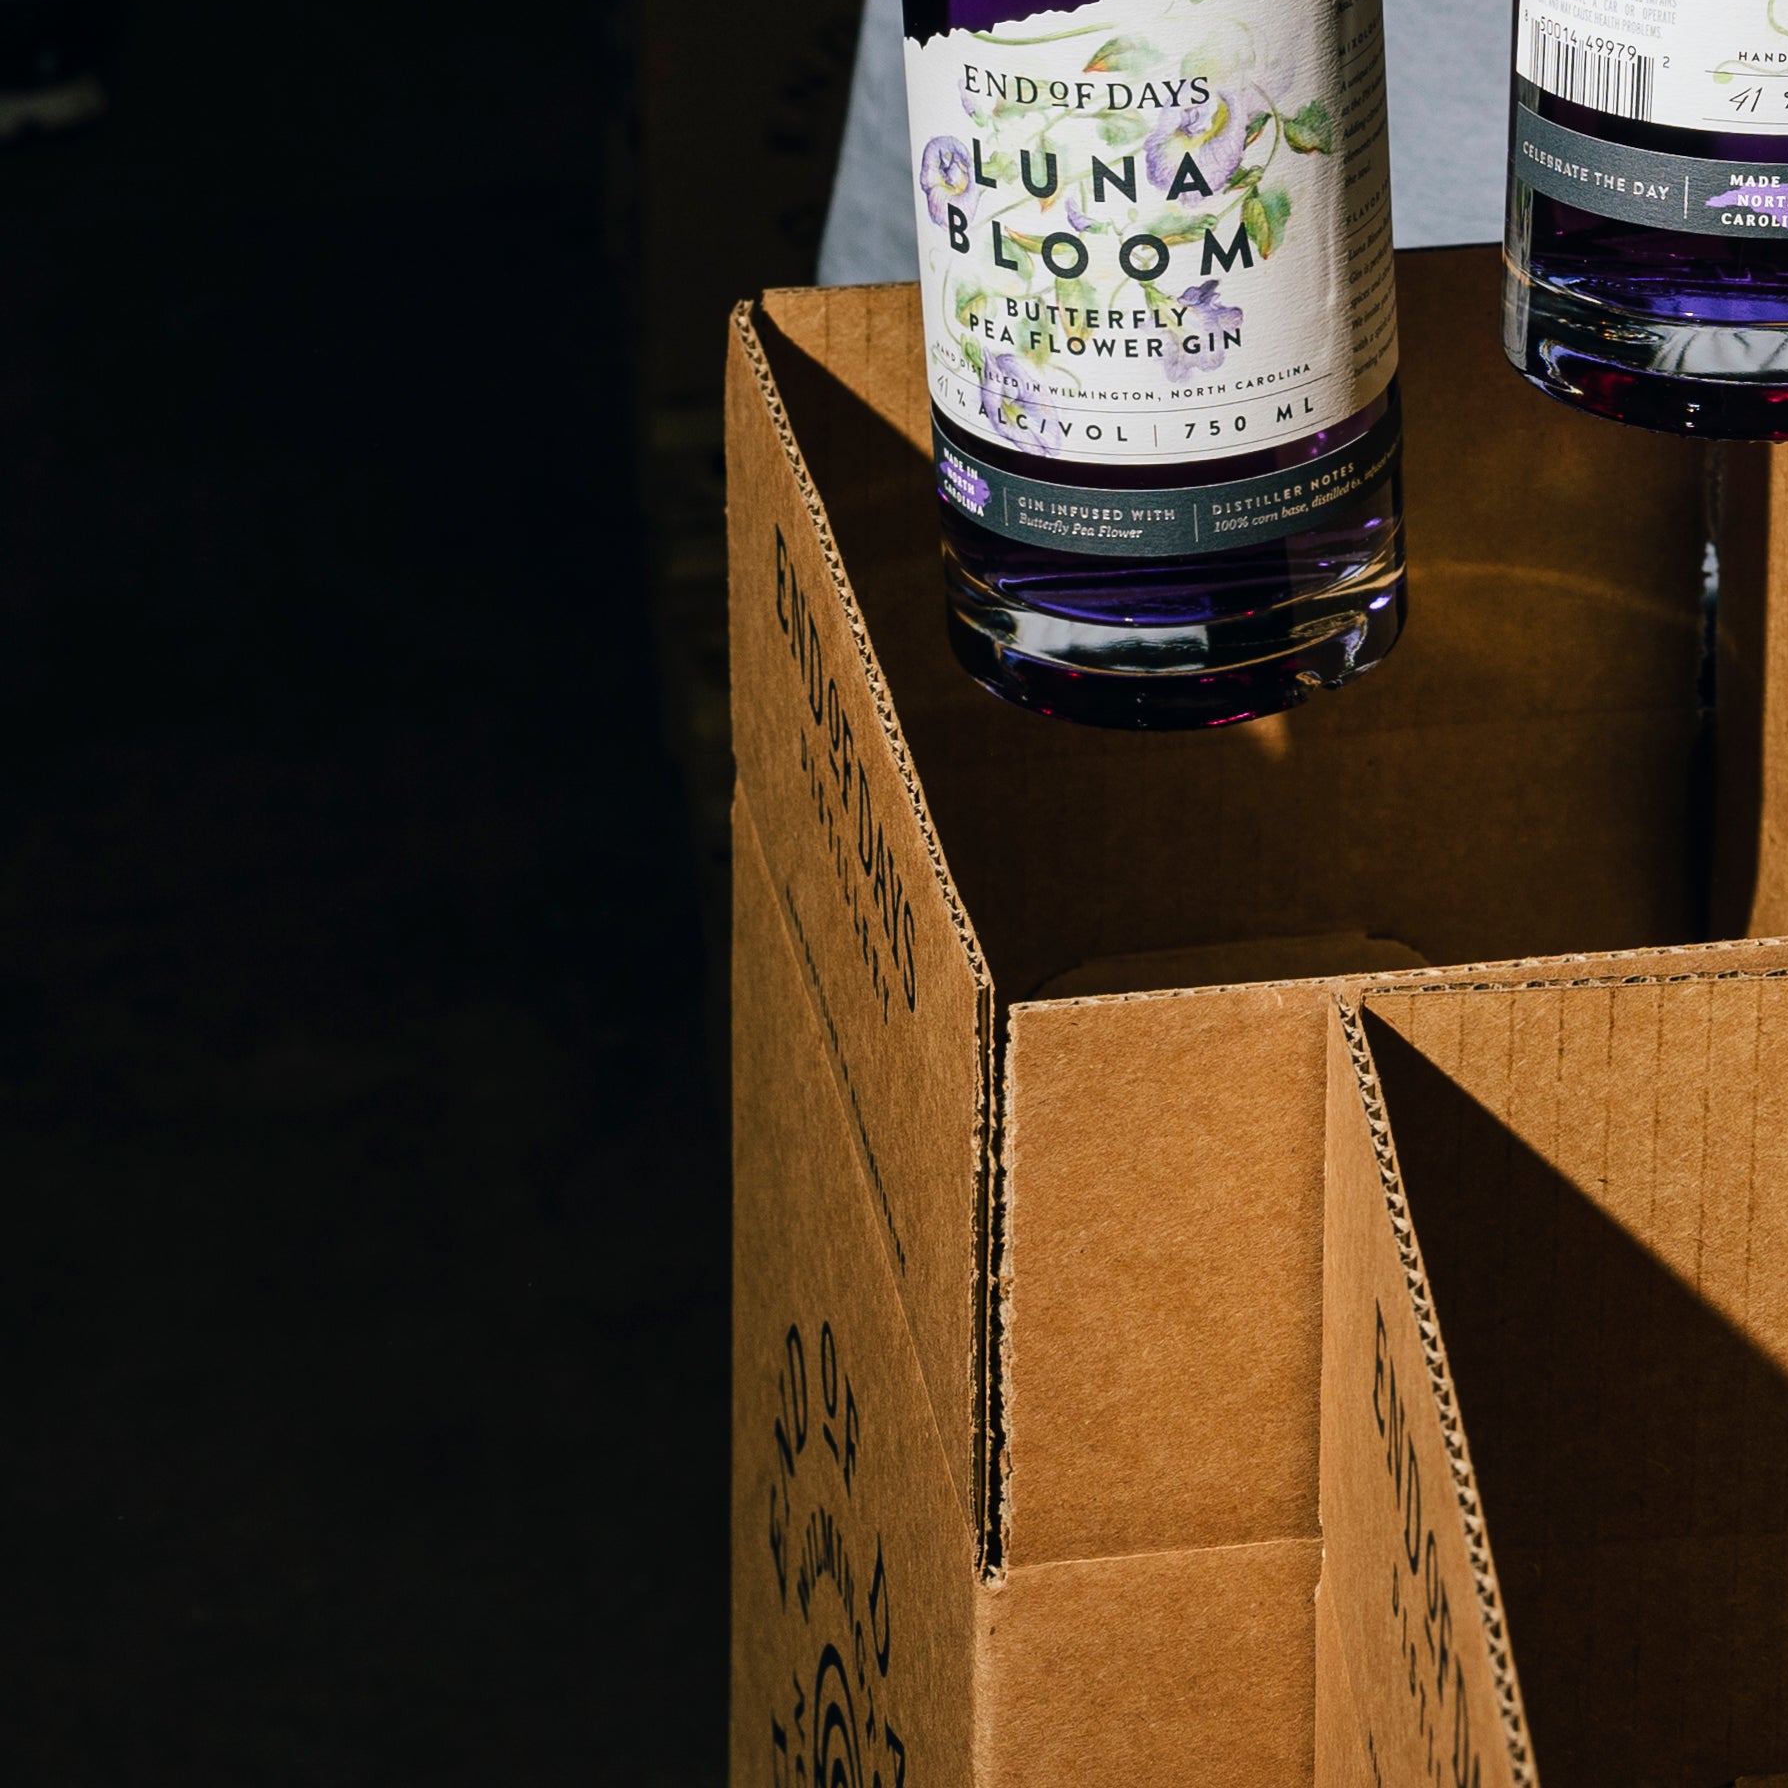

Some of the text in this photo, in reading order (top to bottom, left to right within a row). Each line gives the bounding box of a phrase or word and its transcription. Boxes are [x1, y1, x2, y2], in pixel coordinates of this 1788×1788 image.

[1594, 12, 1620, 30] HEALTH
[1625, 3, 1635, 17] OR
[1643, 8, 1677, 25] OPERATE
[1540, 16, 1578, 44] 50014
[1585, 35, 1637, 61] 49979
[1662, 55, 1671, 69] 2
[1738, 51, 1788, 63] HAND
[963, 63, 1210, 110] END OF DAYS
[1728, 86, 1764, 113] 41
[972, 137, 1214, 204] LUNA
[1522, 140, 1670, 201] CELEBRATE THE DAY
[1729, 173, 1784, 189] MADE
[947, 202, 1254, 281] BLOOM
[969, 313, 1244, 359] PEA FLOWER GIN
[1006, 297, 1188, 330] BUTTERFLY
[959, 357, 1020, 389] DISTILLED
[1025, 382, 1041, 394] IN
[1047, 385, 1162, 402] WILMINGTON,
[1170, 383, 1227, 400] NORTH
[1235, 362, 1312, 391] CAROLINA
[977, 401, 1129, 443] ALC/VOL
[1184, 415, 1248, 441] 750
[1275, 395, 1315, 424] ML
[1018, 495, 1176, 522] GIN INFUSED WITH
[1212, 461, 1356, 517] DISTILLER NOTES
[1212, 513, 1250, 534] 100%
[1251, 510, 1279, 527] corn
[1280, 500, 1310, 522] base,
[1311, 480, 1350, 508] distilled
[1018, 513, 1143, 540] Butterfly Pea Flower
[775, 523, 916, 1013] END OF DAYS
[801, 727, 889, 1025] DISTILLERY
[769, 1323, 809, 1615] END
[1373, 1296, 1453, 1705] END OF
